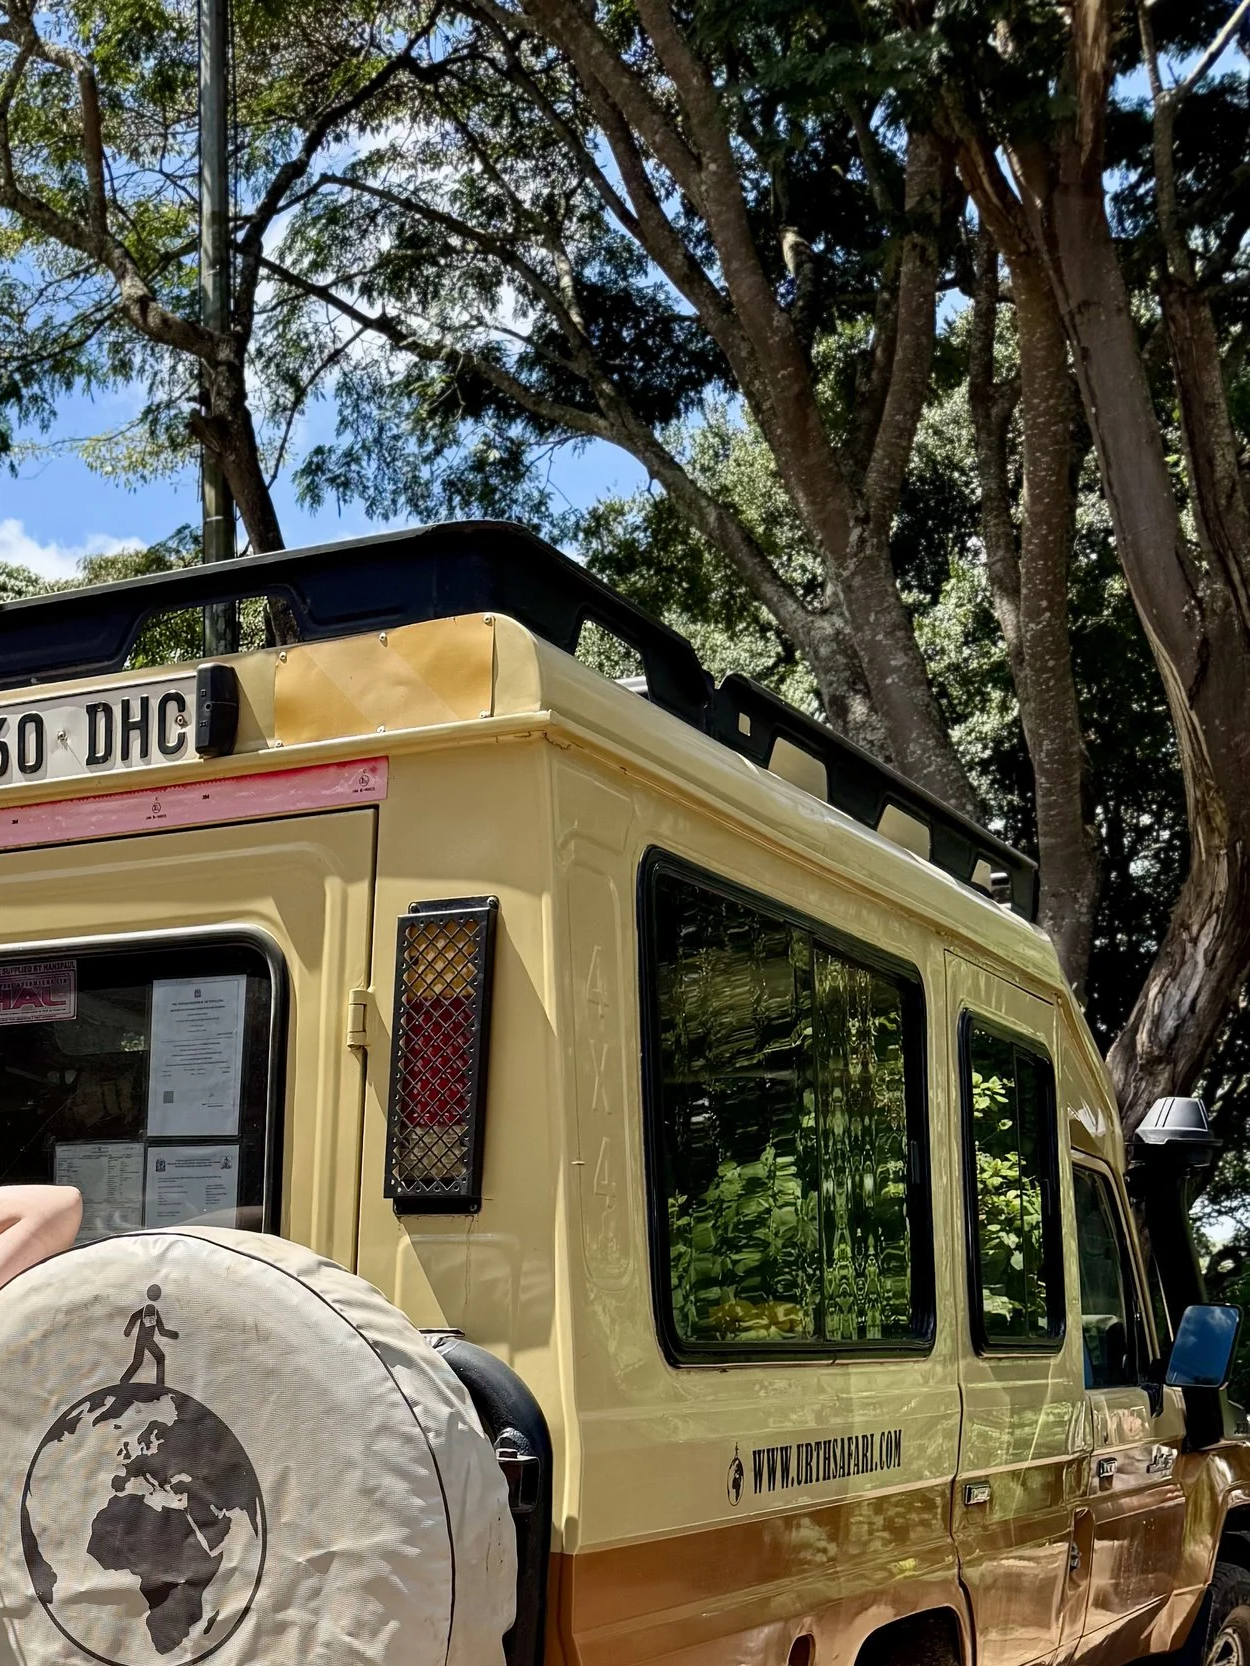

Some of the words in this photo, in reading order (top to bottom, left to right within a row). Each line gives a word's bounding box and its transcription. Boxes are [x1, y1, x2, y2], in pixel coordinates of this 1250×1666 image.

[85, 689, 186, 766] DHC
[2, 965, 33, 975] SUPPLIED
[33, 964, 43, 973] BY
[751, 1429, 902, 1494] WWW.URTHSAFARI.COM
